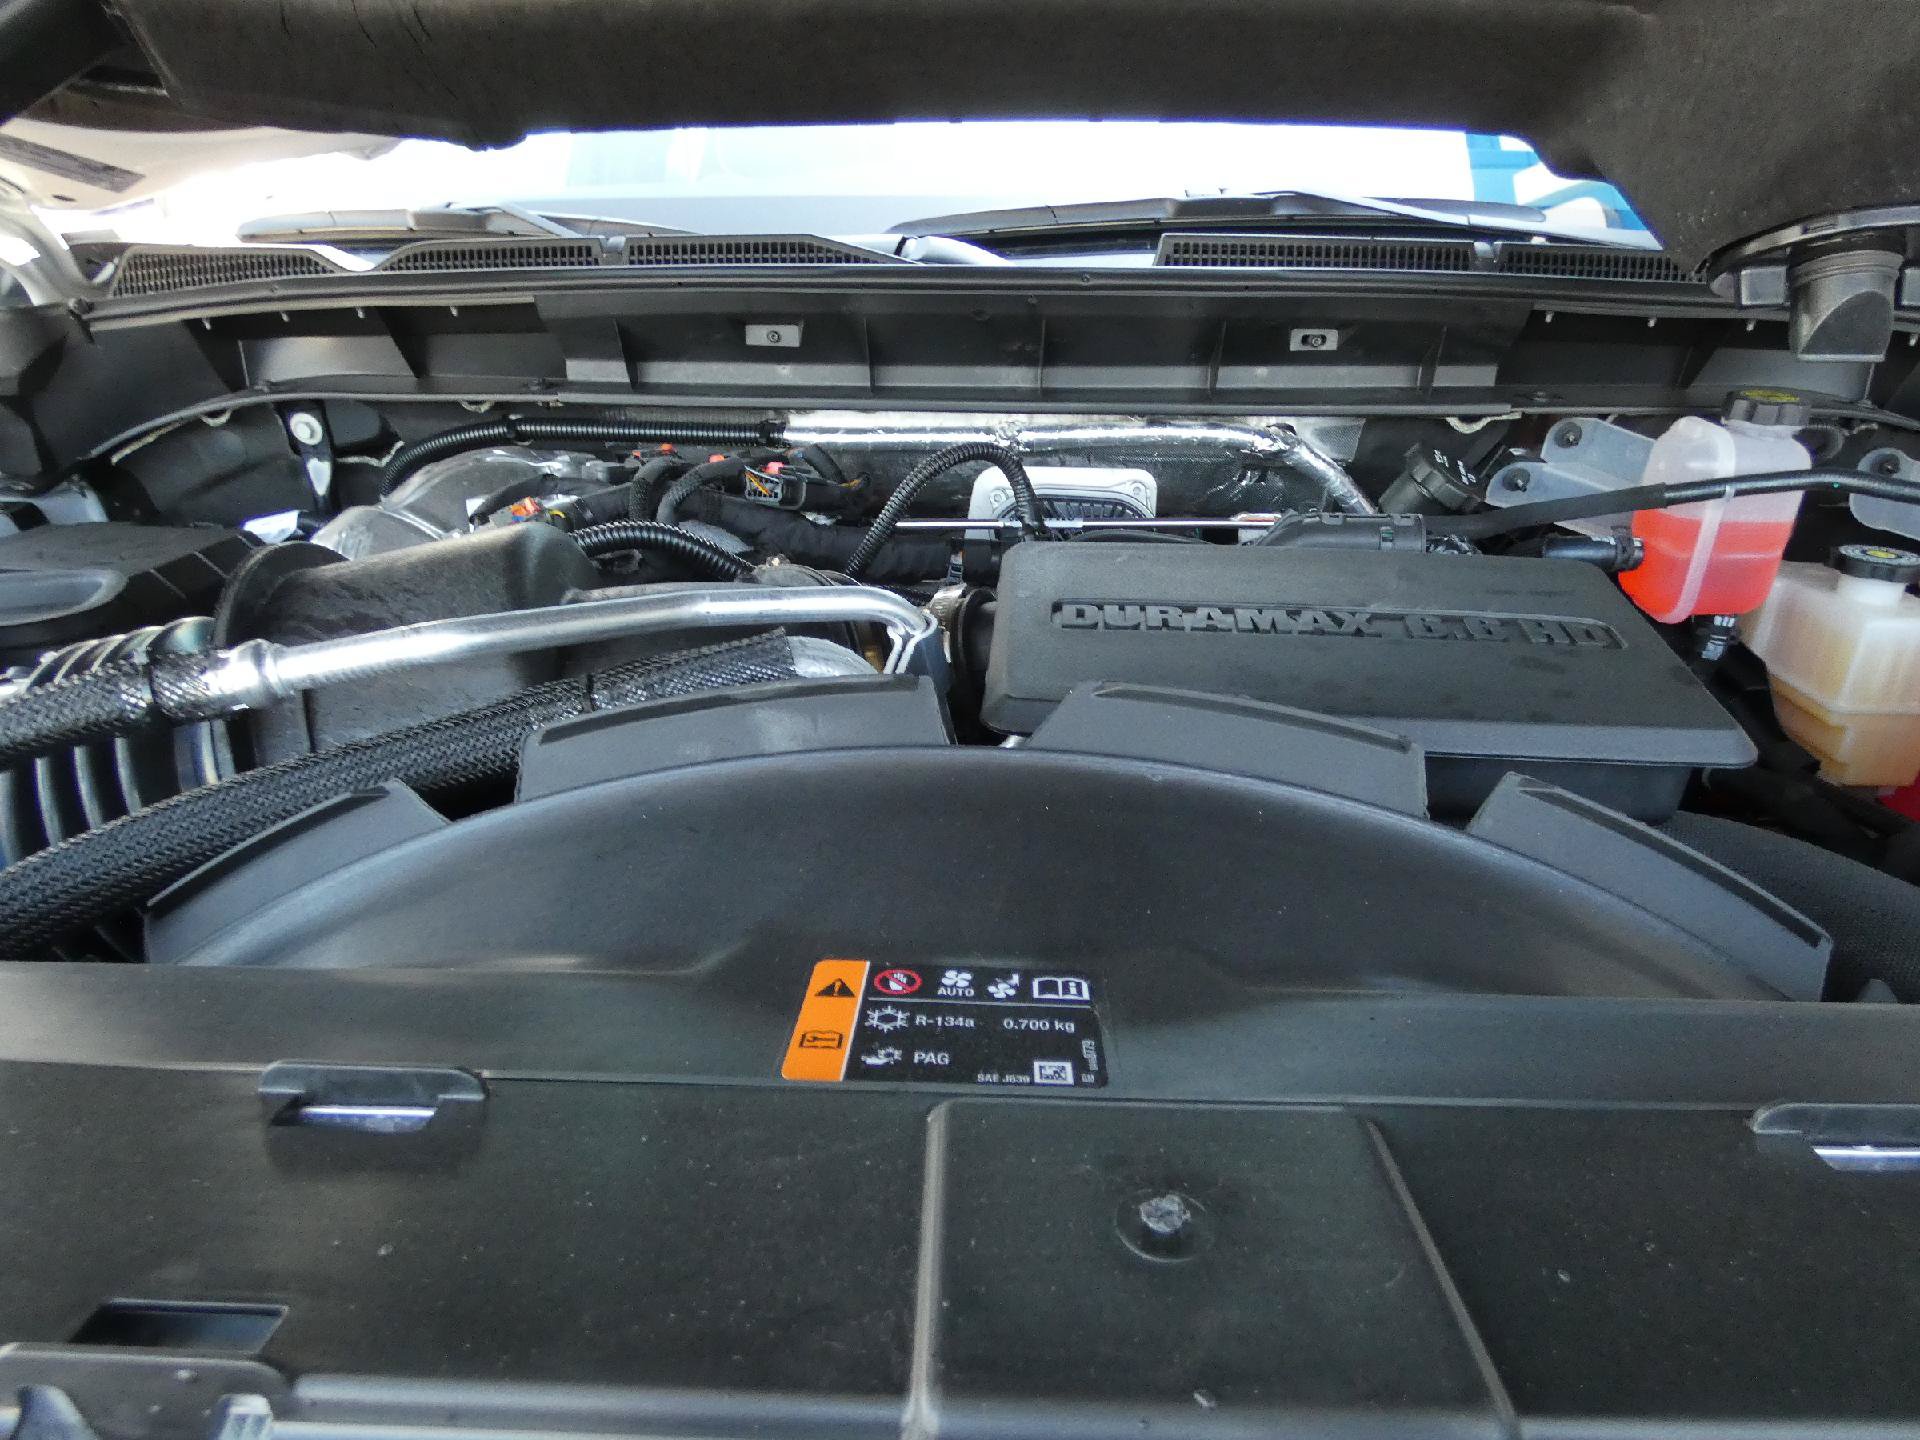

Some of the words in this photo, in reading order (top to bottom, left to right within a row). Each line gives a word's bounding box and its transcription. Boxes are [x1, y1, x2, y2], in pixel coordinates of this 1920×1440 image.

[1061, 604, 1380, 637] DURAMAX
[1517, 618, 1611, 647] HD
[938, 987, 975, 997] AUTO
[915, 1015, 975, 1028] R-134a
[1004, 1018, 1049, 1031] 0.700
[1055, 1018, 1075, 1033] kg
[913, 1052, 950, 1065] PAG
[977, 1073, 999, 1083] SAE
